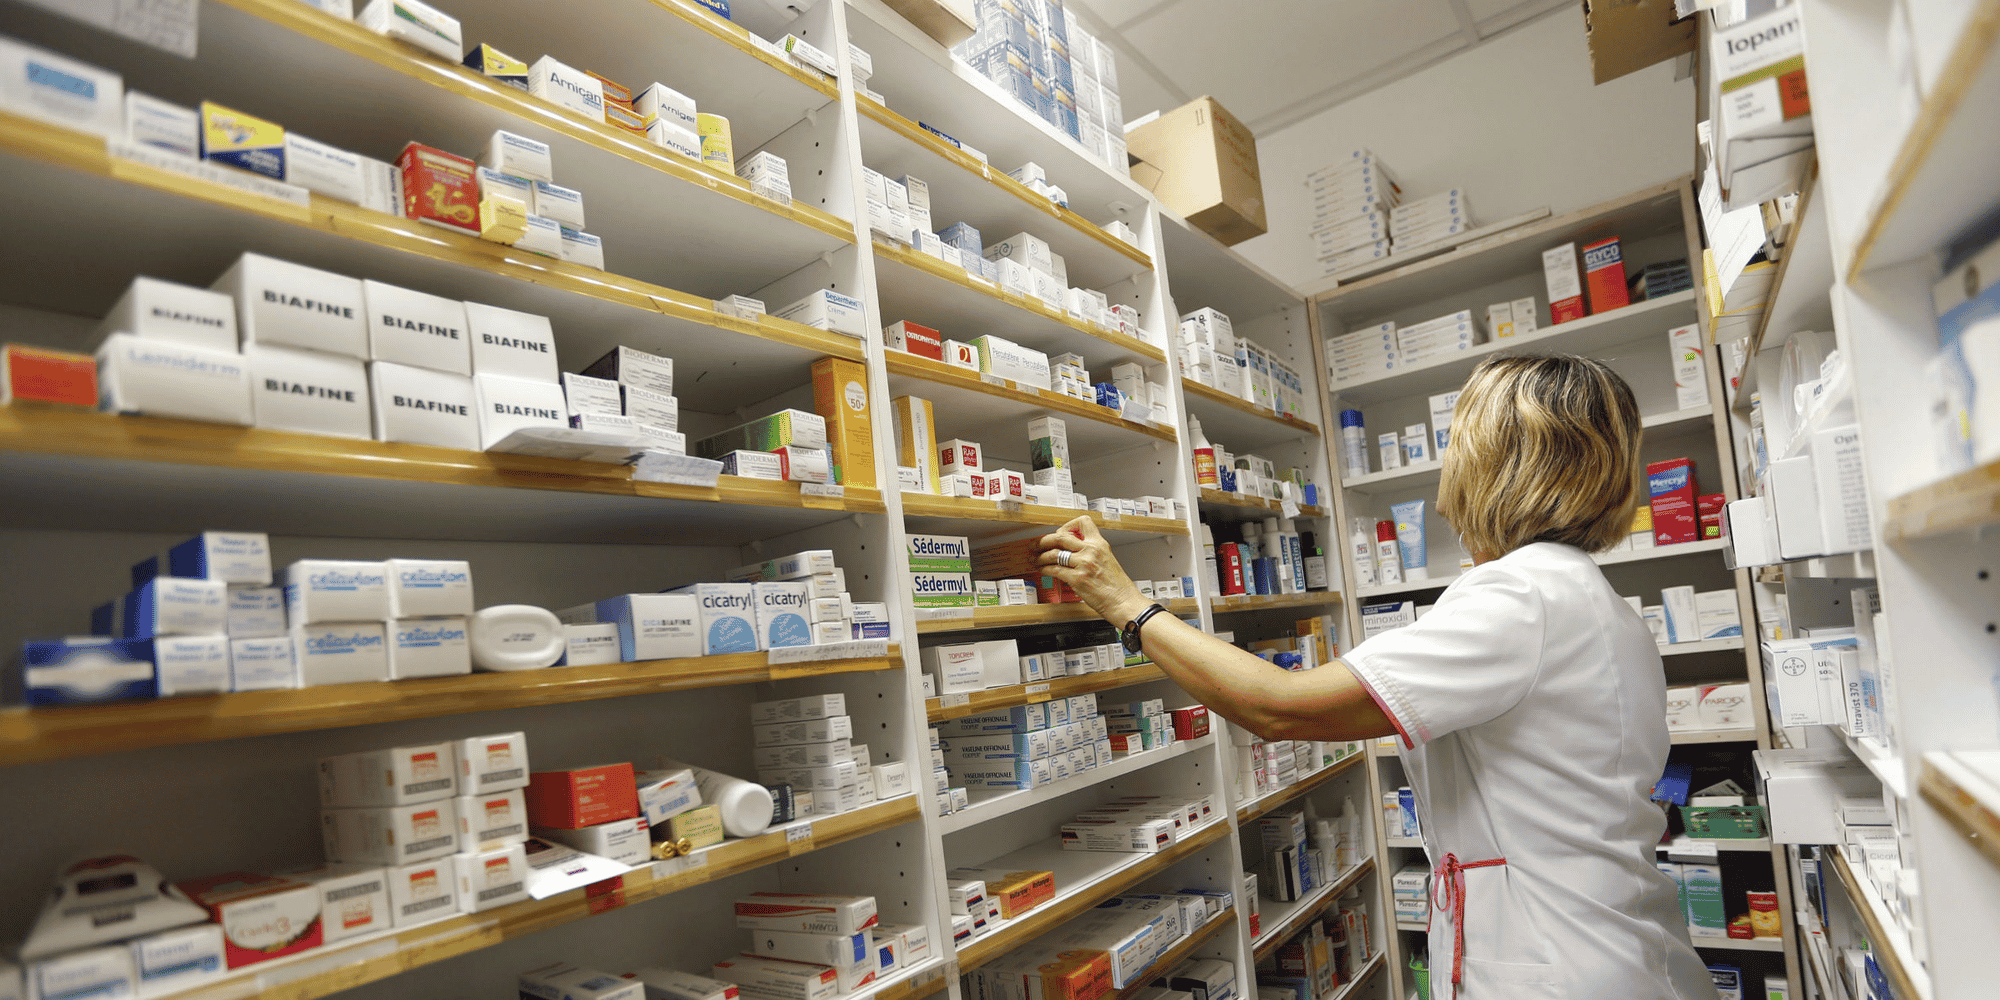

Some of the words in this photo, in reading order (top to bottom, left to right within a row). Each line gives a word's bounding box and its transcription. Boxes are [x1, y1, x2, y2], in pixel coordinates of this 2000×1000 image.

[550, 72, 602, 105] Arnican
[661, 102, 696, 124] Arnigel
[666, 138, 700, 158] Arnigel
[1584, 244, 1620, 266] GLYCO
[264, 289, 354, 320] BIAFINE
[825, 291, 858, 308] Bepanthen
[153, 307, 224, 328] BIAFINE
[382, 314, 459, 340] BIAFINE
[482, 332, 548, 354] BIAFINE
[624, 350, 670, 366] BIODERMA
[569, 373, 615, 390] BIODERMA
[264, 378, 356, 403] BIAFINE
[630, 387, 674, 405] BIODERMA
[393, 394, 468, 417] BIAFINE
[494, 403, 559, 420] BIAFINE
[586, 414, 633, 426] BIODERMA
[793, 411, 824, 424] BIODERMA
[639, 425, 683, 442] BIODERMA
[740, 454, 779, 464] BIODERMA
[791, 448, 825, 458] BIODERMA
[963, 447, 976, 457] RAP
[972, 477, 984, 486] RAP
[1009, 478, 1020, 487] RAP
[1650, 474, 1686, 488] Mercryl
[912, 537, 966, 558] Sédermyl
[914, 575, 968, 595] Sédermyl
[703, 593, 752, 611] cicatryl
[764, 591, 807, 608] cicatryl
[1364, 613, 1408, 626] minoxidil
[1849, 682, 1859, 697] 370
[1704, 696, 1746, 707] PAROEX
[1850, 701, 1864, 734] Ultravist
